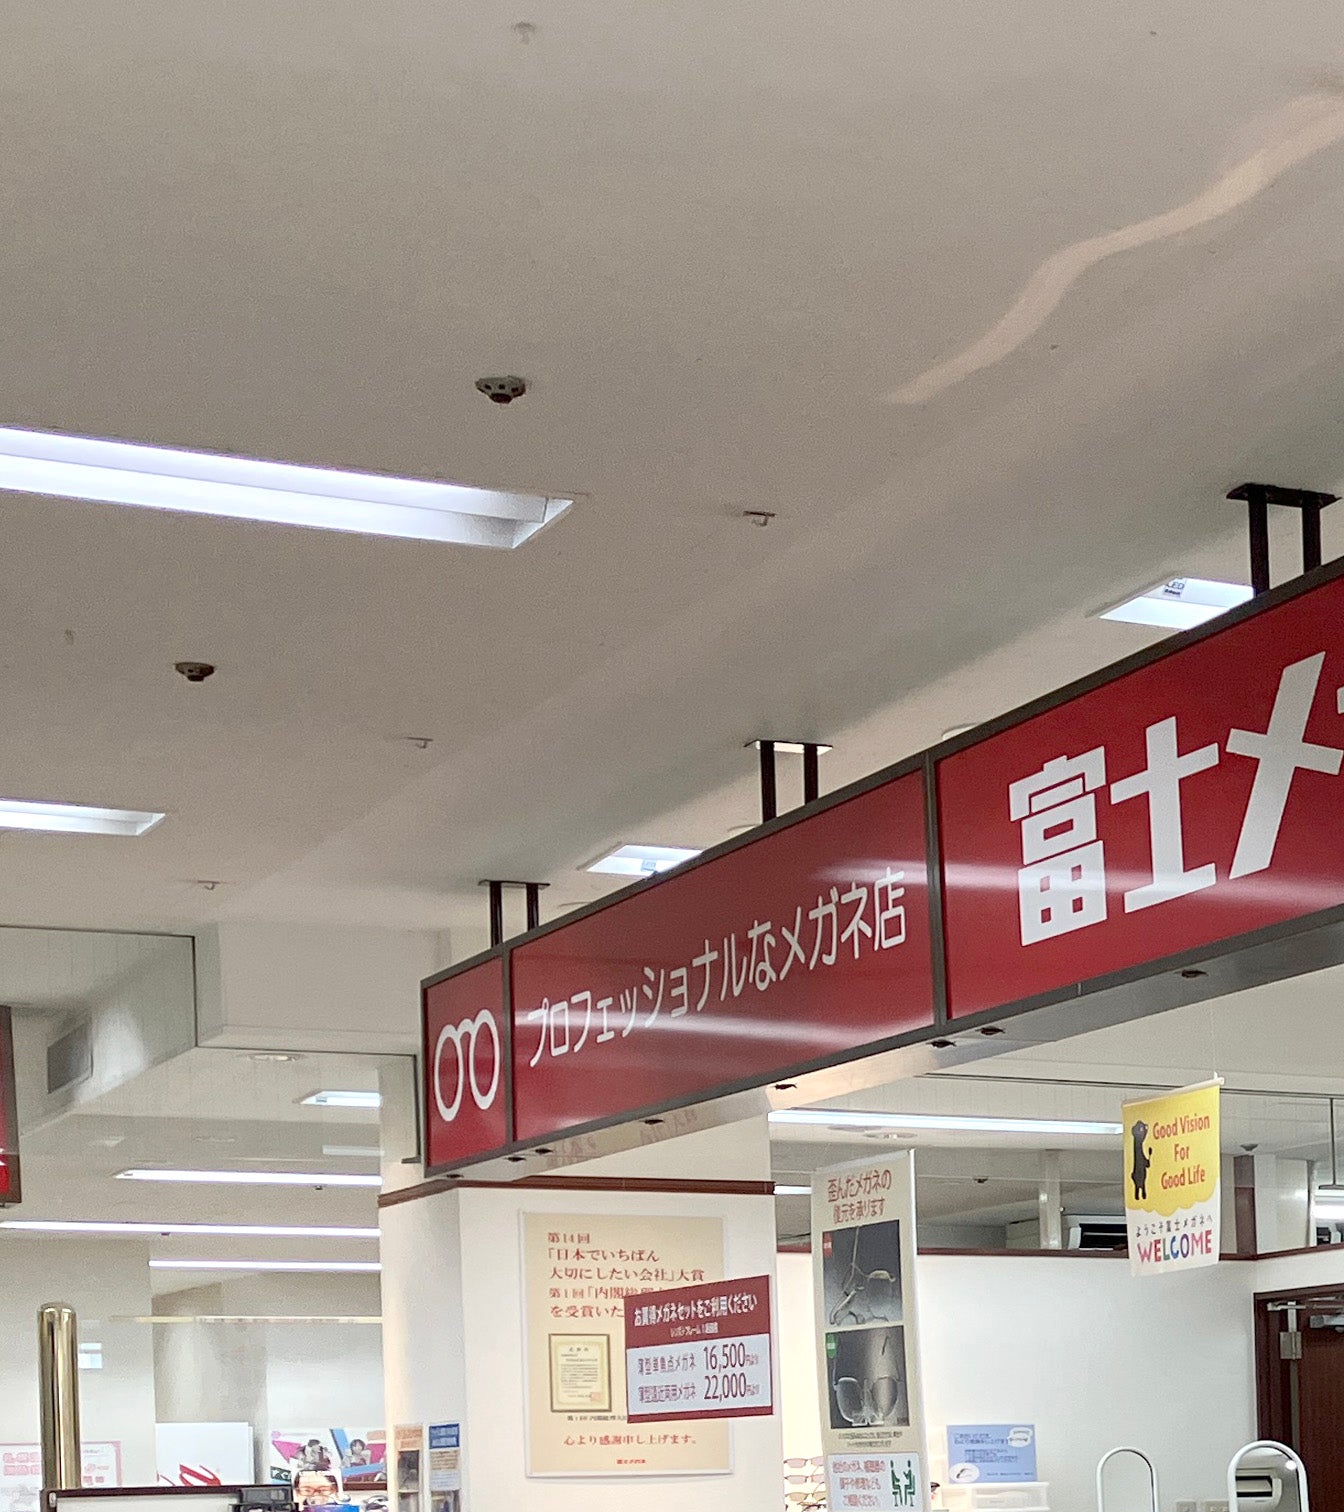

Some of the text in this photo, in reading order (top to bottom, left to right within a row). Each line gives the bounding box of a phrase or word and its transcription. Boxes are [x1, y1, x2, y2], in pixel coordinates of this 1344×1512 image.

[527, 866, 907, 1068] プロフェッショナルなメガネ店
[1152, 1113, 1211, 1140] Good Vision
[1174, 1143, 1190, 1162] For
[828, 1169, 892, 1203] 歪んだメガネの
[1161, 1164, 1206, 1191] Good Life
[1137, 1229, 1213, 1264] WELCOME
